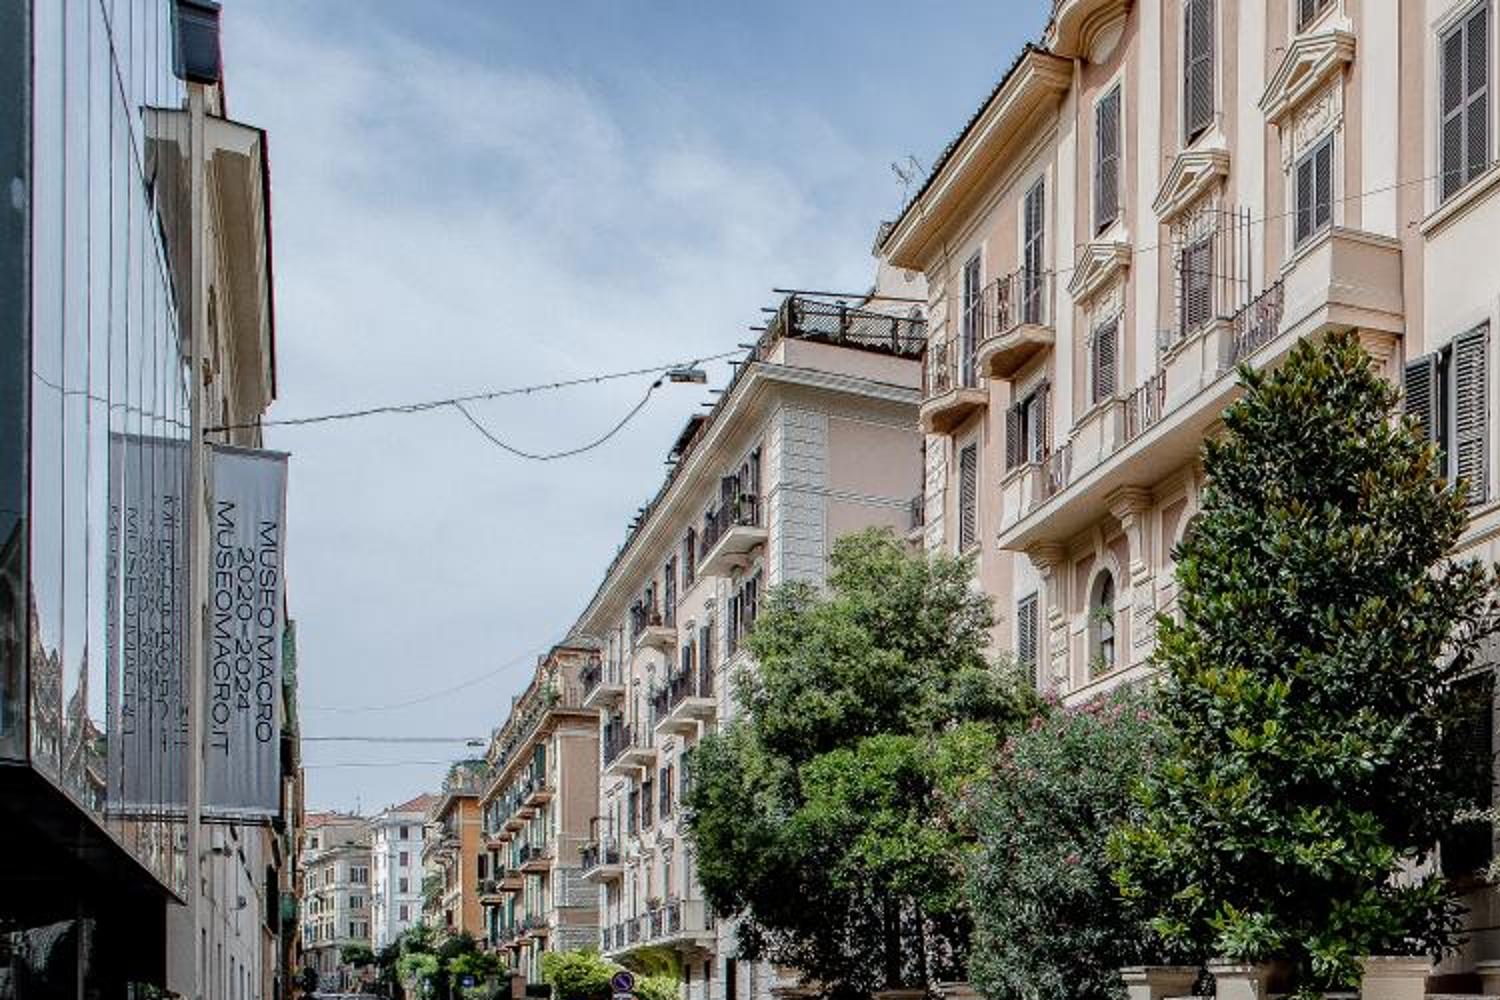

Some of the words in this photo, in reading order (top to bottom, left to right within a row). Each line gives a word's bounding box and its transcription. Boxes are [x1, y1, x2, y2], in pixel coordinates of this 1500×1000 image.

[257, 520, 277, 628] MUSEO
[211, 501, 235, 757] MUSEOMACRO.IT
[255, 634, 275, 743] MACRO
